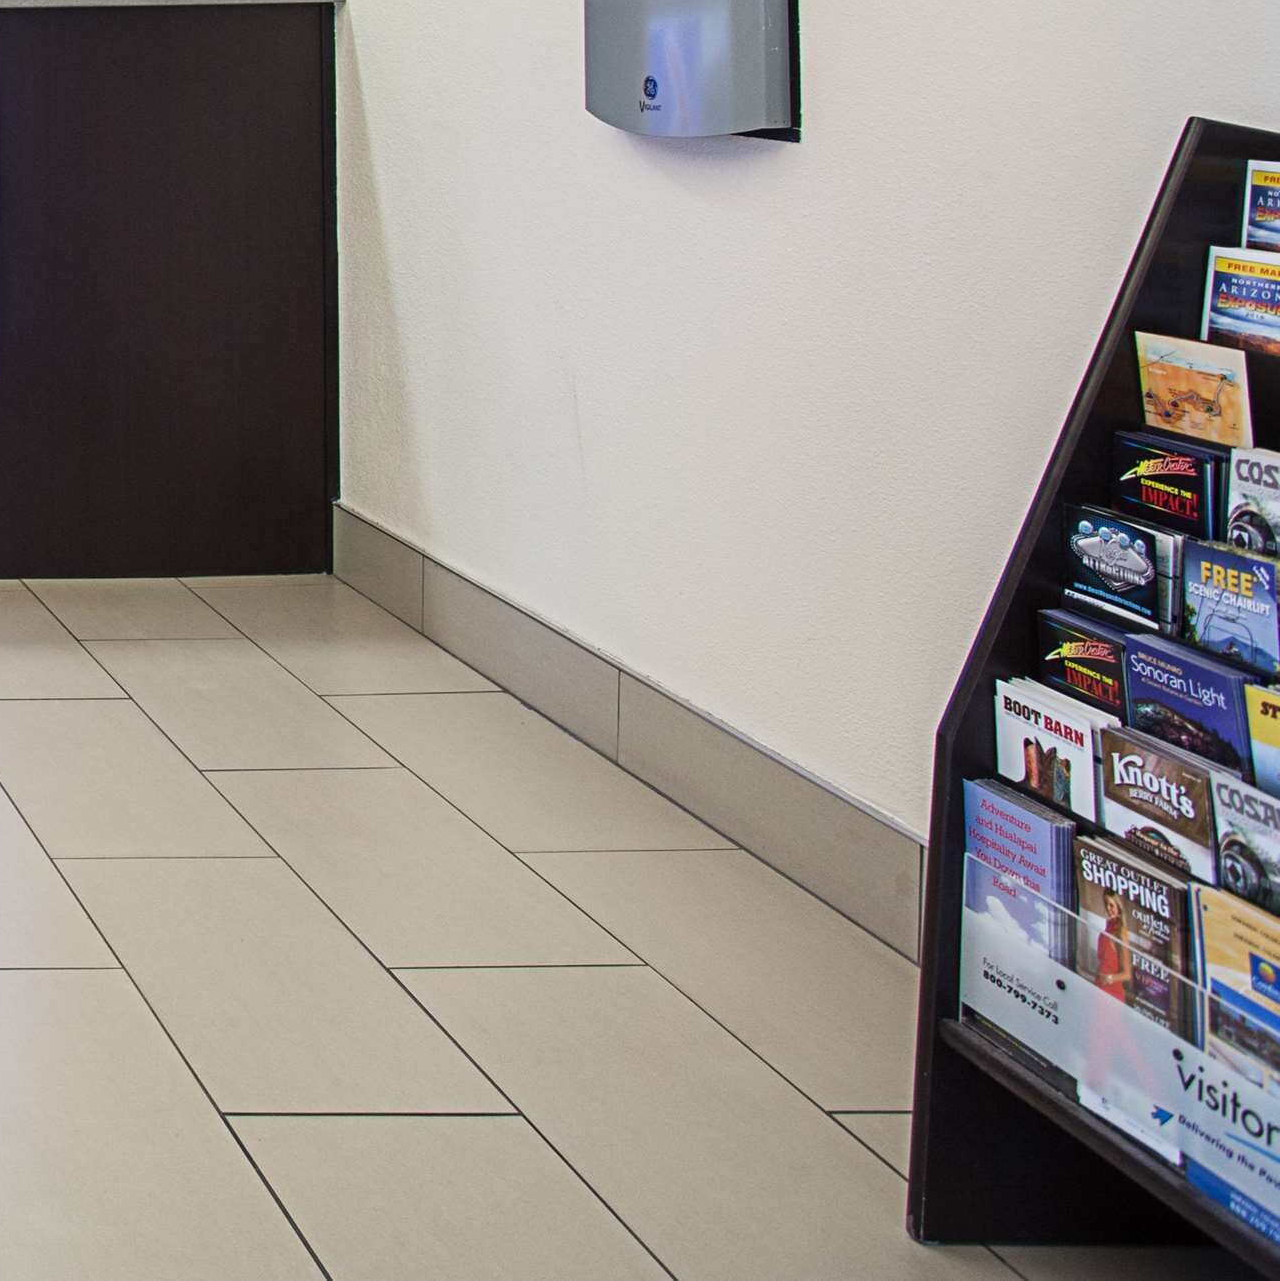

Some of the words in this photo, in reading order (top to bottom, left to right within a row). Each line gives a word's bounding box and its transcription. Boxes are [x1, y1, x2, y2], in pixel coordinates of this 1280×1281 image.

[1227, 262, 1256, 273] FREE
[1141, 478, 1179, 496] EXPERIENCE
[1180, 489, 1192, 500] THE
[1141, 486, 1199, 518] IMPACT!
[1200, 560, 1255, 599] FREE
[1188, 580, 1220, 601] SCENIC
[1222, 590, 1271, 616] CHAIRLIFT
[1064, 659, 1101, 680] EXPERIENCE
[1066, 668, 1121, 705] IMPACT!
[1130, 654, 1187, 693] Sonoran
[1188, 678, 1227, 710] Light
[1003, 694, 1041, 726] BOOT
[1043, 714, 1084, 747] BARN
[1111, 751, 1196, 820] Knott's
[1128, 788, 1153, 807] BERRY
[976, 815, 993, 832] and
[980, 799, 1032, 833] Adventure
[1216, 782, 1280, 831] COSA
[969, 825, 1017, 862] Hospitality
[1018, 854, 1048, 879] Await
[976, 846, 992, 866] You
[992, 857, 1021, 880] Down
[992, 875, 1018, 897] Road
[1080, 848, 1119, 872] GREAT
[1120, 866, 1168, 896] OUTLET
[1081, 859, 1171, 919] SHOPPING
[983, 956, 994, 970] For
[995, 965, 1015, 984] Local
[1016, 977, 1042, 1002] Service
[1043, 995, 1058, 1012] Call
[1132, 952, 1171, 983] FREE
[1178, 1114, 1235, 1159] Delivering
[1237, 1149, 1255, 1172] the
